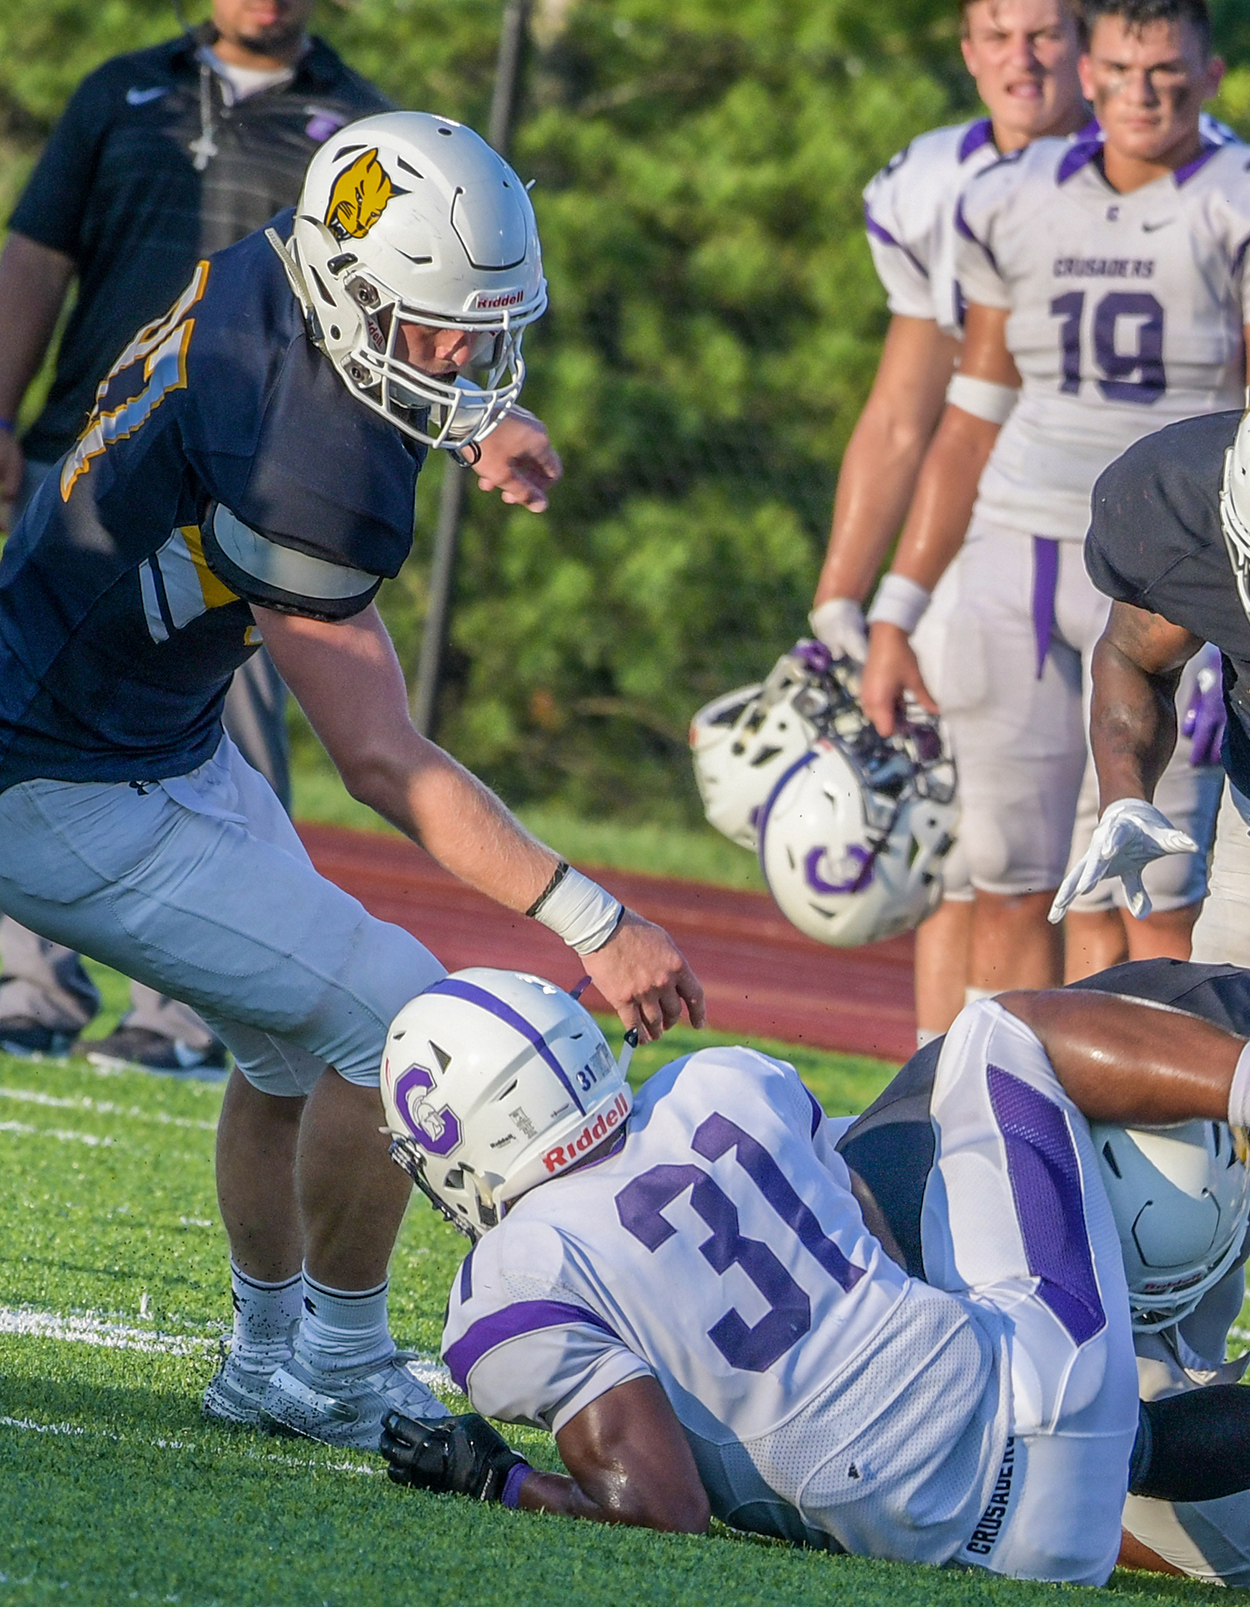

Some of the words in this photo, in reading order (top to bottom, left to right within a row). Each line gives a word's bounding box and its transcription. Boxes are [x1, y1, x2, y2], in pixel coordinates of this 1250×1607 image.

[1053, 258, 1155, 279] CRUSADERS
[477, 290, 525, 309] Riddell
[1050, 290, 1168, 405] 19
[576, 1063, 597, 1092] 31
[541, 1091, 630, 1174] Riddell
[614, 1110, 868, 1374] 31
